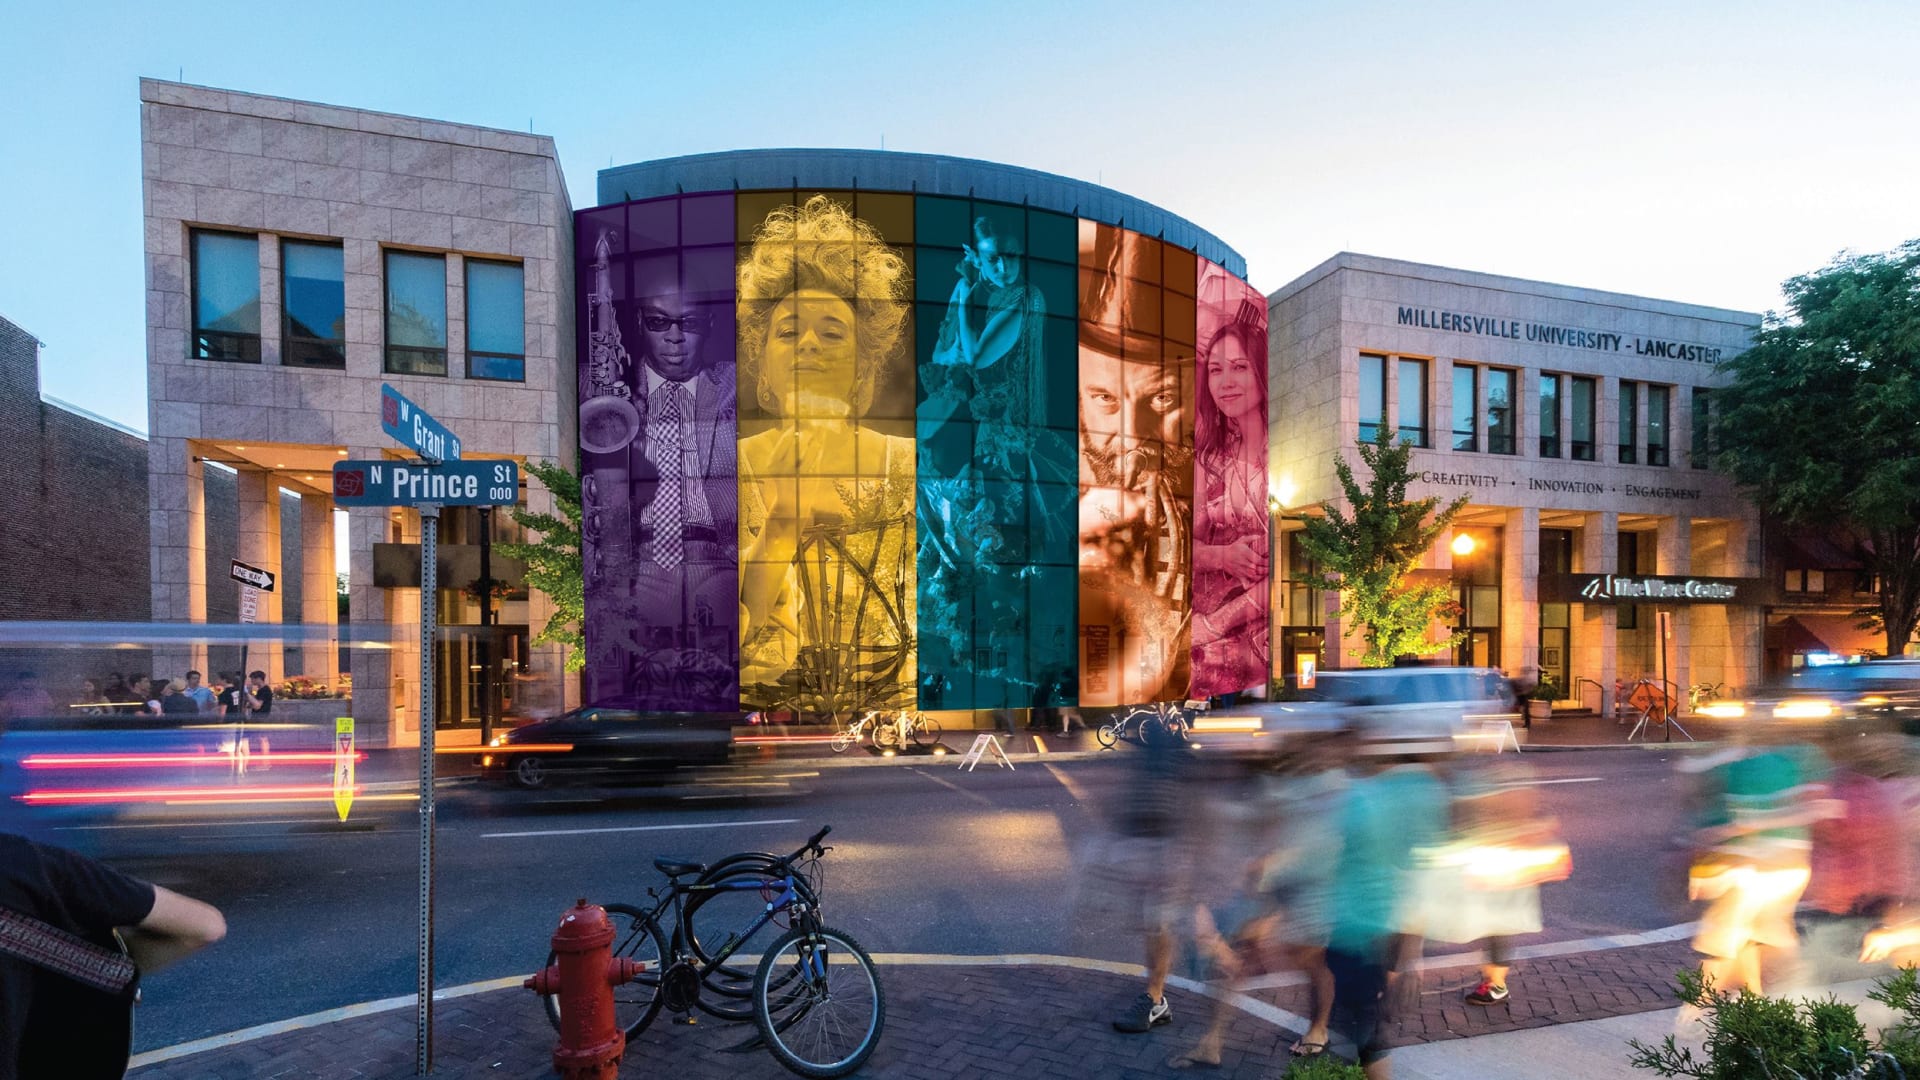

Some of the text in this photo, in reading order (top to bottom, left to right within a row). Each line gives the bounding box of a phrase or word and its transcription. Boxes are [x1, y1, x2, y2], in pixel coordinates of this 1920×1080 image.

[1397, 306, 1521, 340] MILLERSVILLE
[1526, 323, 1622, 351] UNIVERSITY
[1636, 338, 1721, 364] LANCASTER
[401, 399, 460, 460] W Grant St
[371, 464, 511, 498] N Prince St
[1421, 470, 1701, 500] CREATIVITY INNOVATION ENGAGEMENT
[235, 567, 262, 581] ONE WAY
[1614, 578, 1644, 597] The
[1685, 580, 1737, 599] Center
